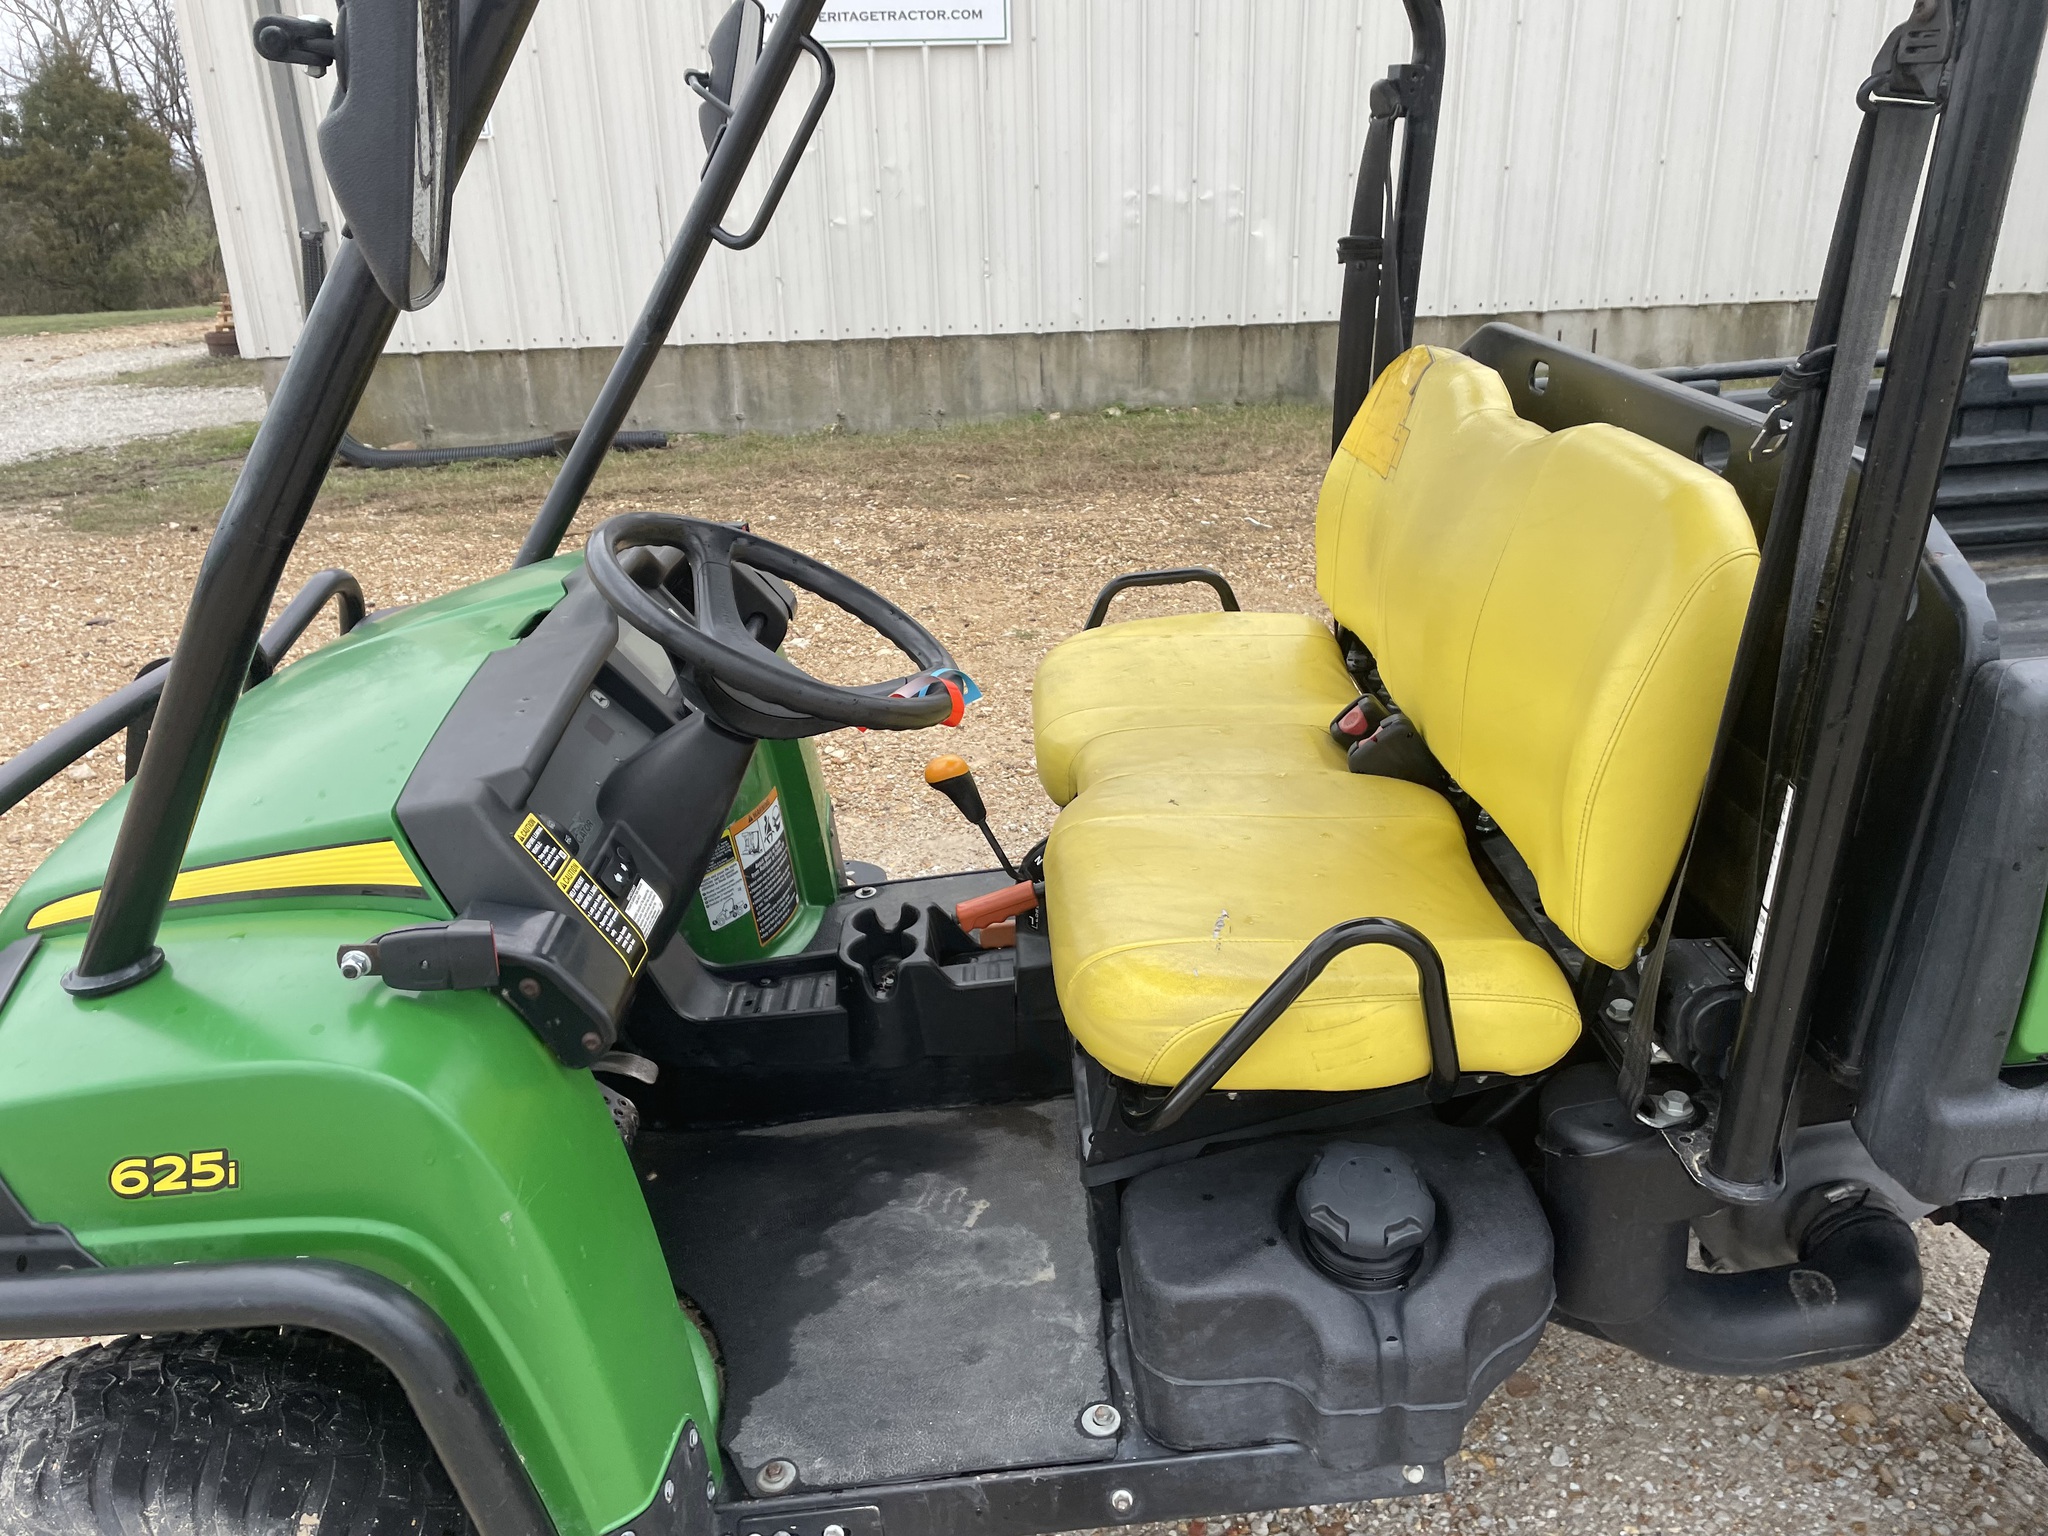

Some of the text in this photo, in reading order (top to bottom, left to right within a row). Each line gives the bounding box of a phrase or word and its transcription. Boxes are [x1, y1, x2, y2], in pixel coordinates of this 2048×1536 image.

[521, 818, 536, 837] CAUTION
[575, 819, 594, 844] GATOR
[565, 862, 580, 885] CAUTION
[109, 1148, 239, 1199] 625i
